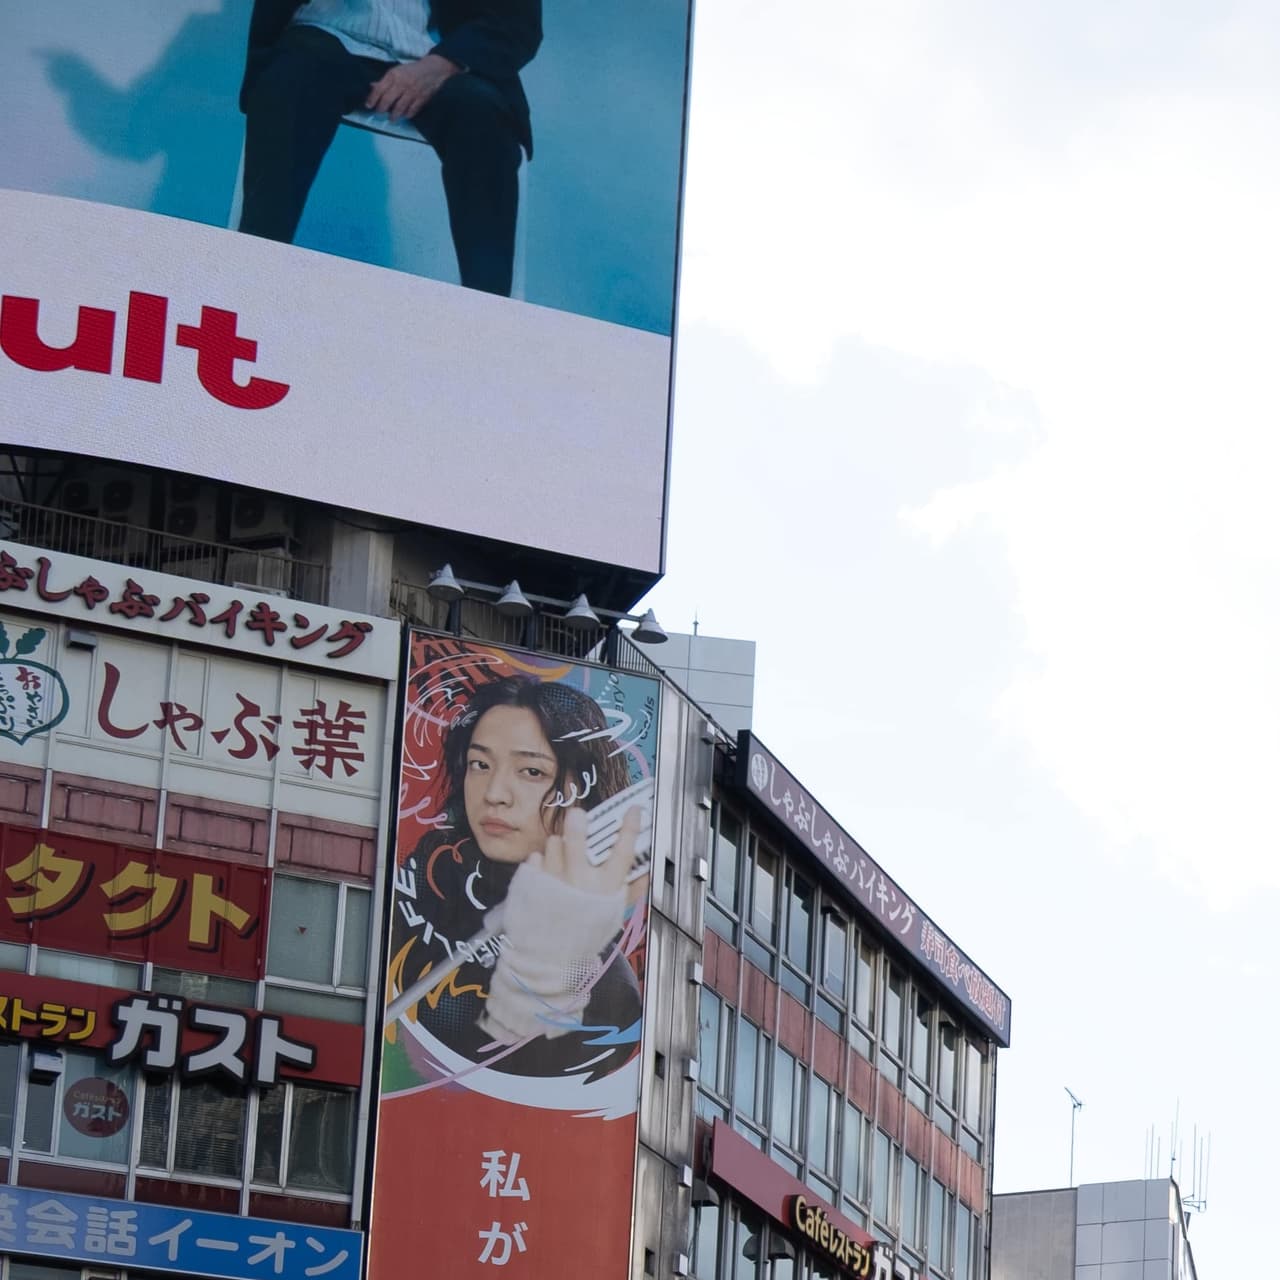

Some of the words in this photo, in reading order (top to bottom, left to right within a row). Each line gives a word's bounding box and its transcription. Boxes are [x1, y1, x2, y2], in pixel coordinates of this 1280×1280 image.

[0, 291, 290, 410] ult
[97, 661, 367, 780] しゃぶ葉
[5, 842, 250, 945] タクト
[110, 998, 313, 1084] ガスト
